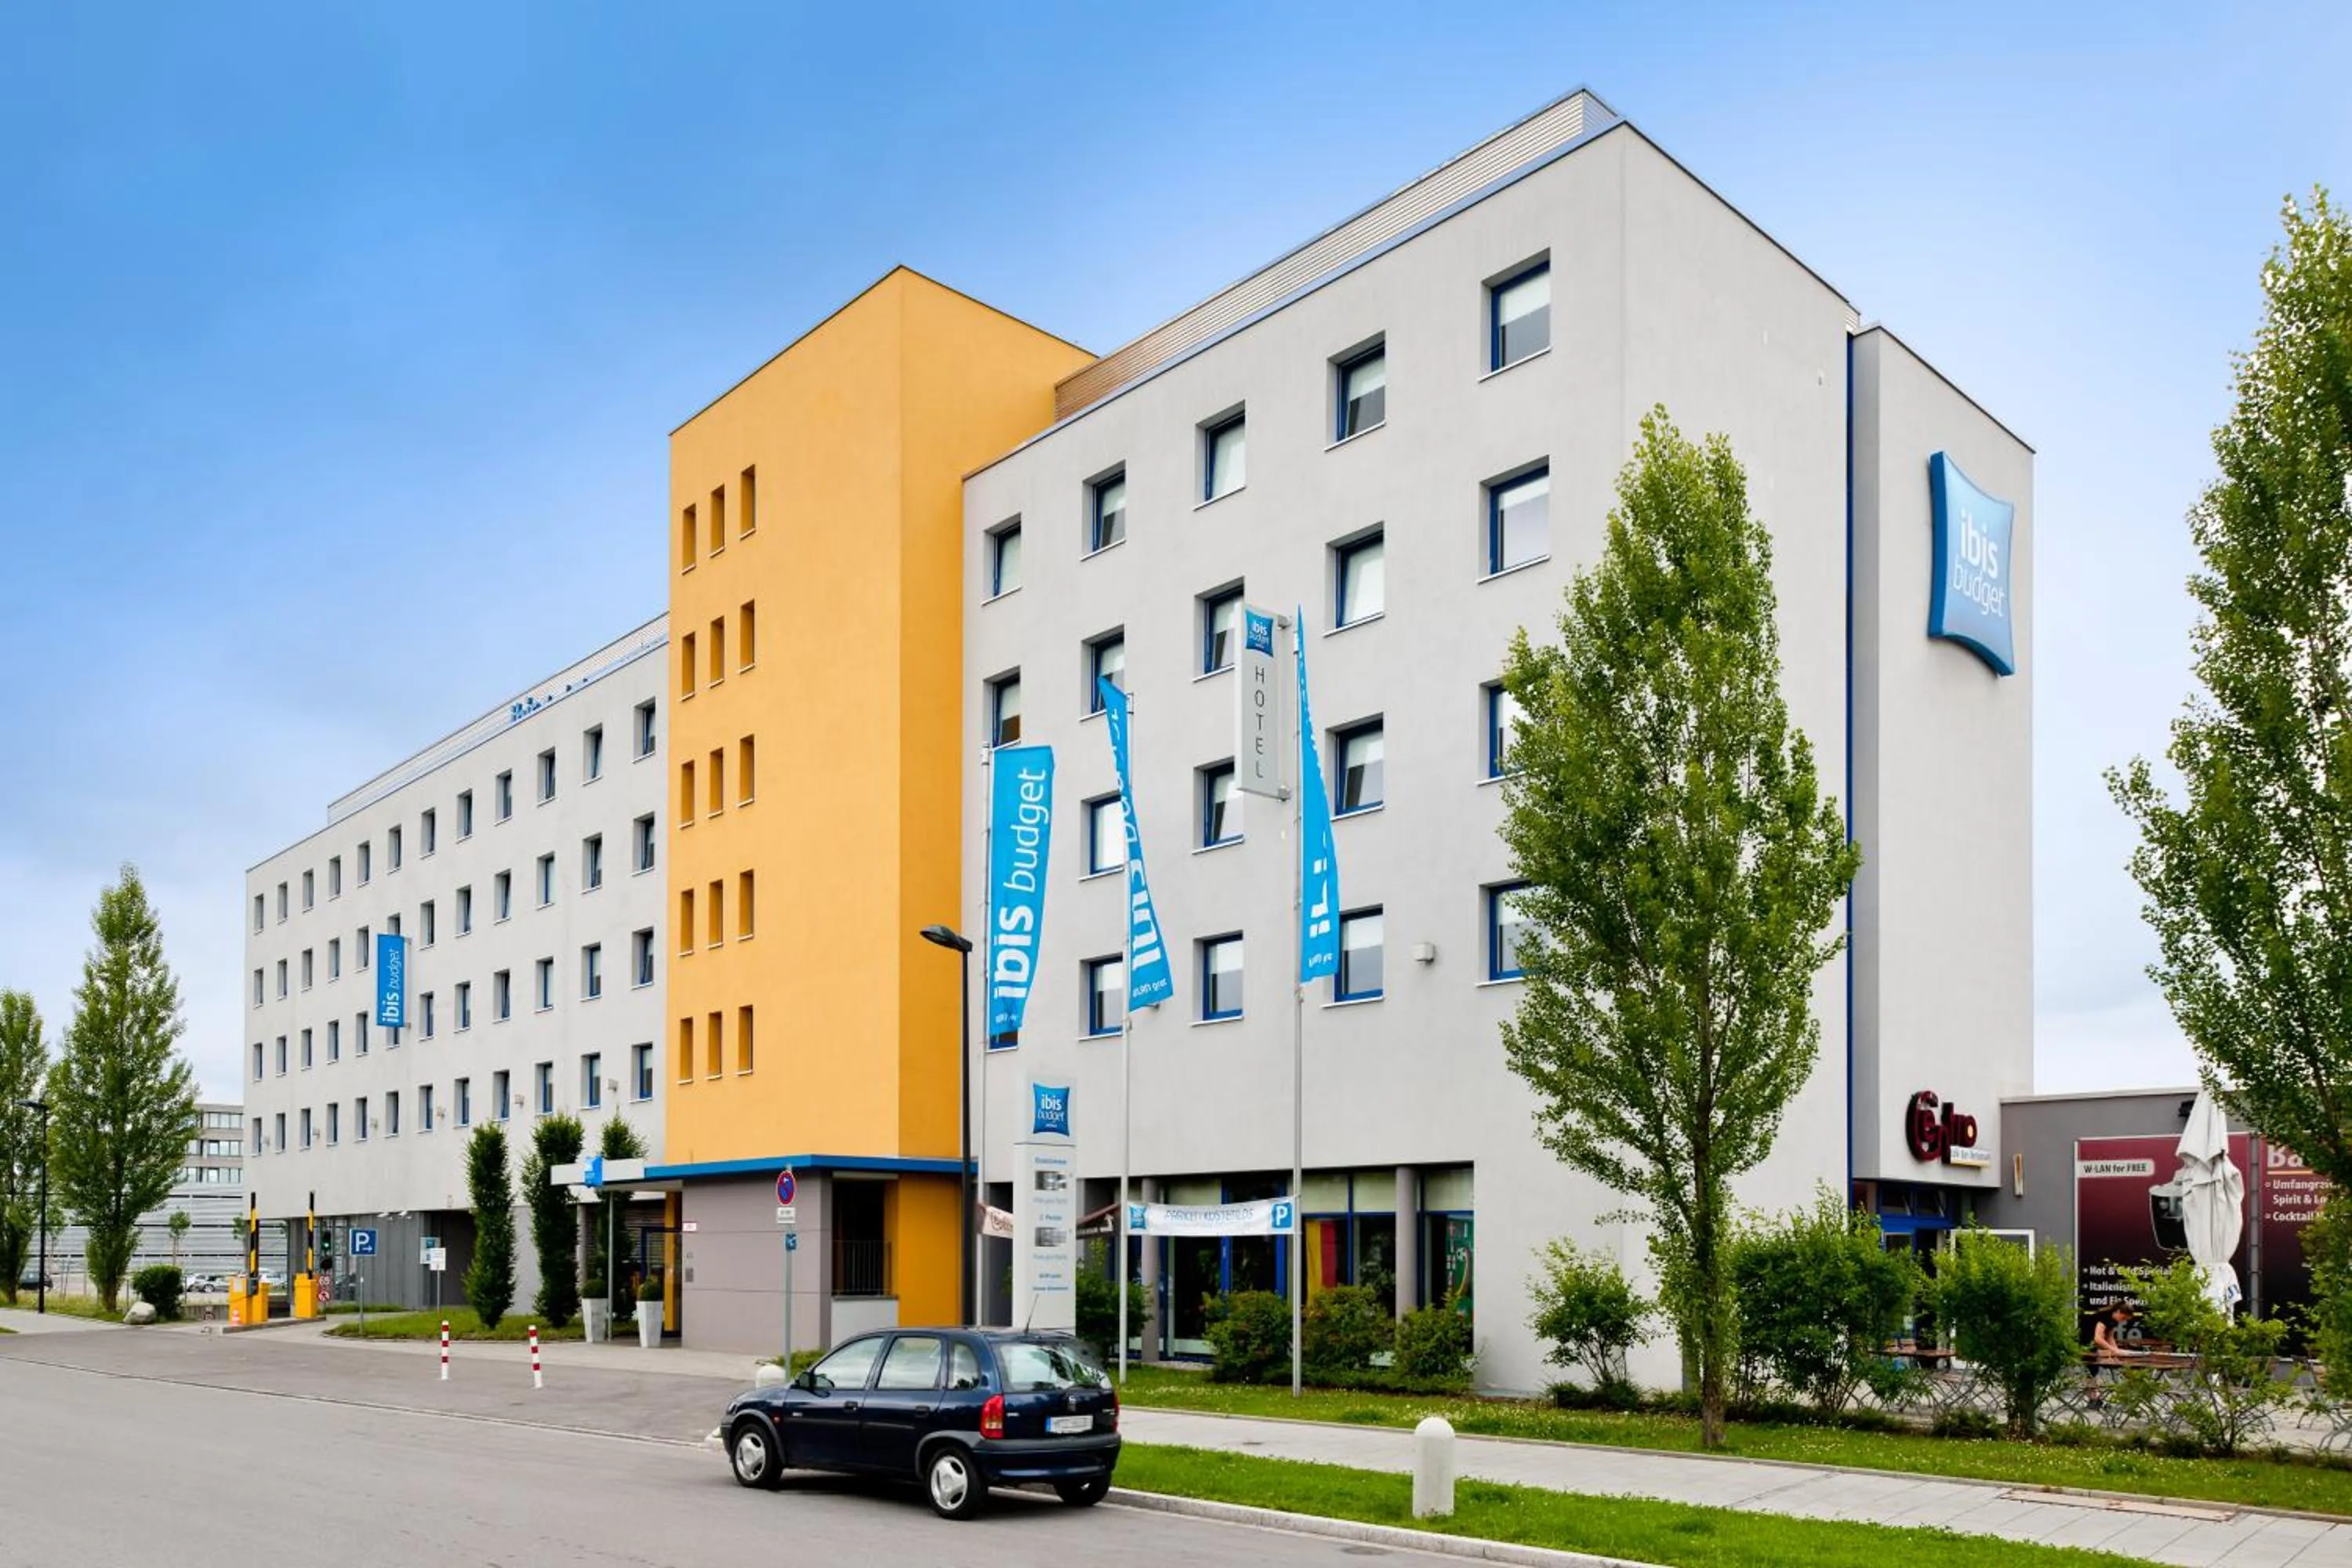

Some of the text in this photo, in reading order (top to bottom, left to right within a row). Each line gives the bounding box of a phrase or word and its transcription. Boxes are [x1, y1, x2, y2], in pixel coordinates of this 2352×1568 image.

[1960, 508, 1999, 579] ibis
[1953, 553, 2005, 618] budget
[1254, 665, 1265, 779] HOTEL
[1003, 768, 1050, 894] budget
[993, 905, 1035, 1000] ibis
[382, 947, 402, 1023] ibis budget
[1041, 1094, 1062, 1111] ibis
[2083, 1163, 2147, 1174] W-LAN for FREE
[2273, 1194, 2302, 1206] Spirit
[2303, 1194, 2312, 1204] &
[355, 1232, 370, 1252] P
[2089, 1266, 2106, 1276] Hot
[2089, 1296, 2107, 1305] und
